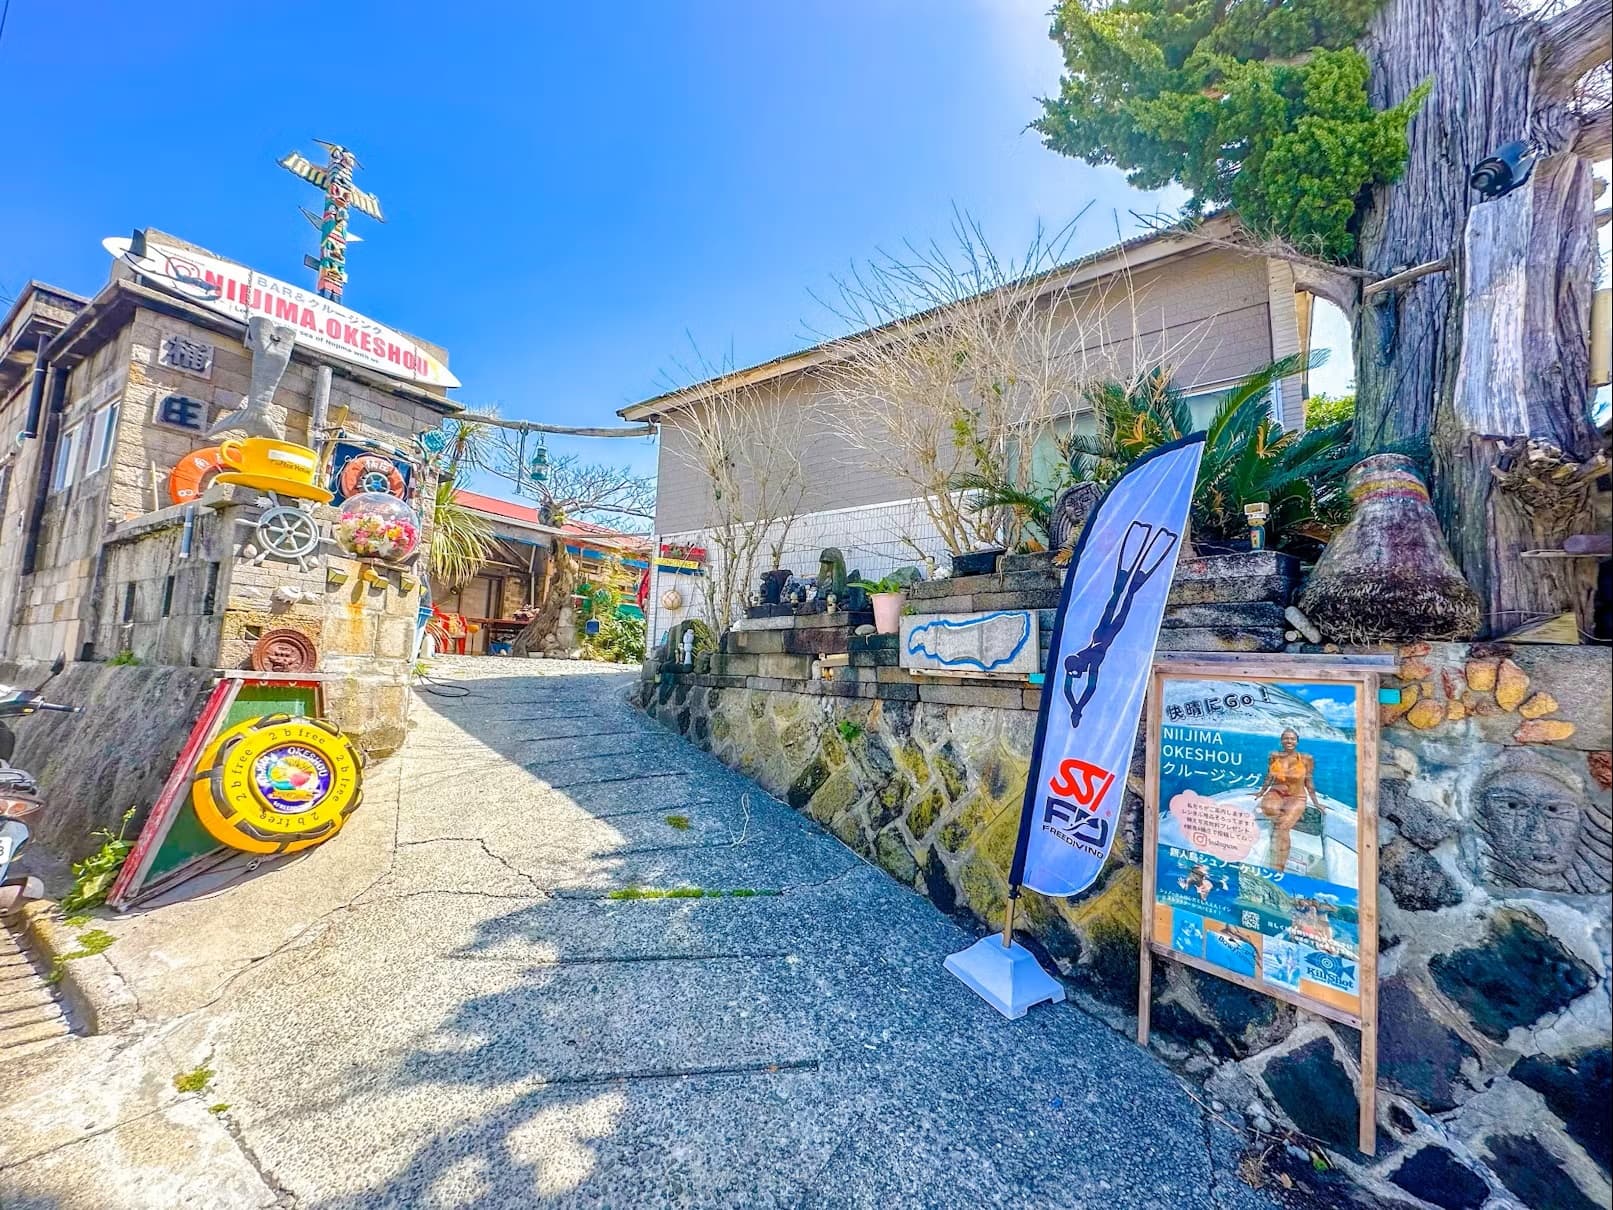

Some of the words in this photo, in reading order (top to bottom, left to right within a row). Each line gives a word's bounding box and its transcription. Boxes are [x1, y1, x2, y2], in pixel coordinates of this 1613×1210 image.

[268, 732, 278, 741] 2
[284, 726, 292, 736] b
[298, 729, 326, 744] free
[1163, 727, 1223, 746] NIIJIMA
[234, 748, 254, 775] free
[336, 754, 344, 762] 2
[1162, 744, 1243, 766] OKESHOU
[341, 765, 349, 773] b
[1162, 761, 1263, 788] クルージング
[231, 780, 242, 788] b
[332, 777, 351, 802] free
[236, 793, 247, 802] 2
[259, 812, 291, 828] free
[297, 816, 306, 826] b
[310, 811, 320, 821] 2
[1042, 824, 1105, 860] FREEDIVING
